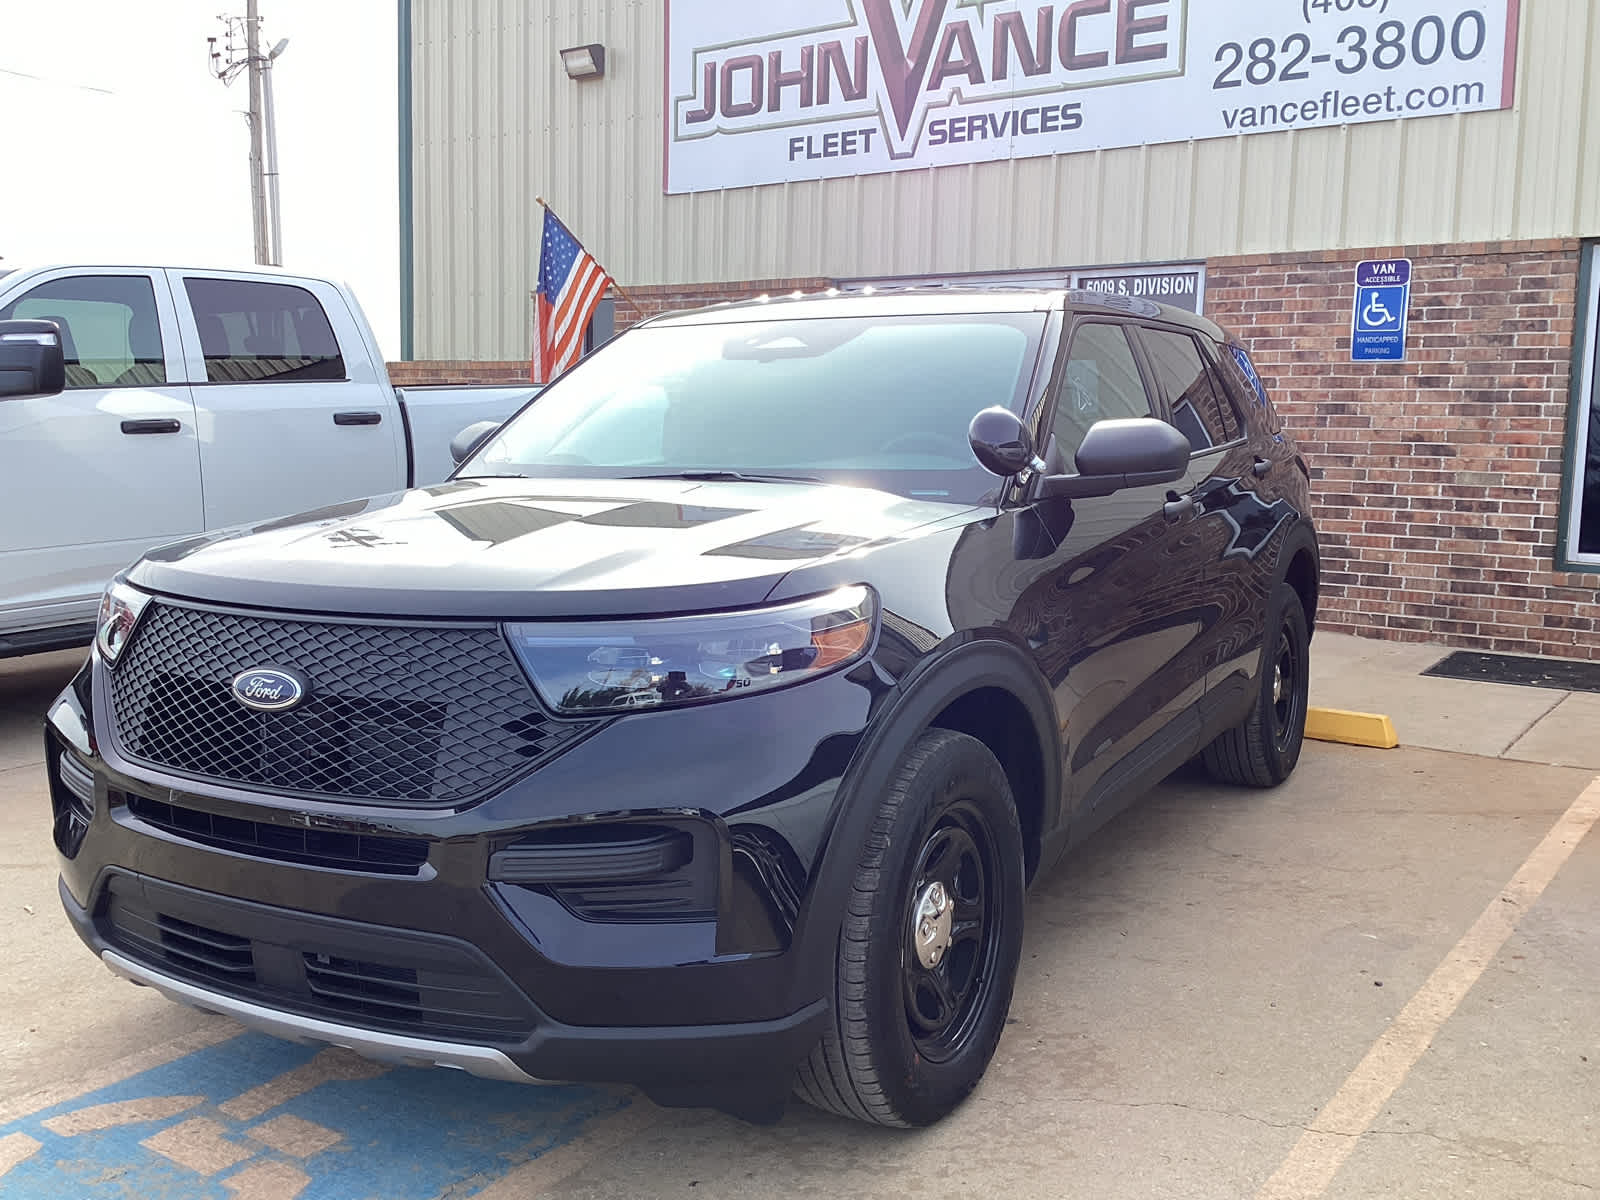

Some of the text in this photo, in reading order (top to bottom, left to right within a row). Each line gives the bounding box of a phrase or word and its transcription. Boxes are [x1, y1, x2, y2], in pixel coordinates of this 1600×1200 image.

[1212, 10, 1487, 90] 282-3800
[686, 0, 1170, 142] JOHN VANCE
[1222, 81, 1485, 129] vancefleet.com
[789, 103, 1082, 161] FLEET SERVICES
[1365, 275, 1401, 283] ACCESSIBLE
[1372, 263, 1396, 275] VAN
[1086, 280, 1115, 294] 5009
[1134, 276, 1195, 296] DIVISION
[1356, 336, 1399, 344] HANDICAPPED
[245, 676, 283, 700] Ford
